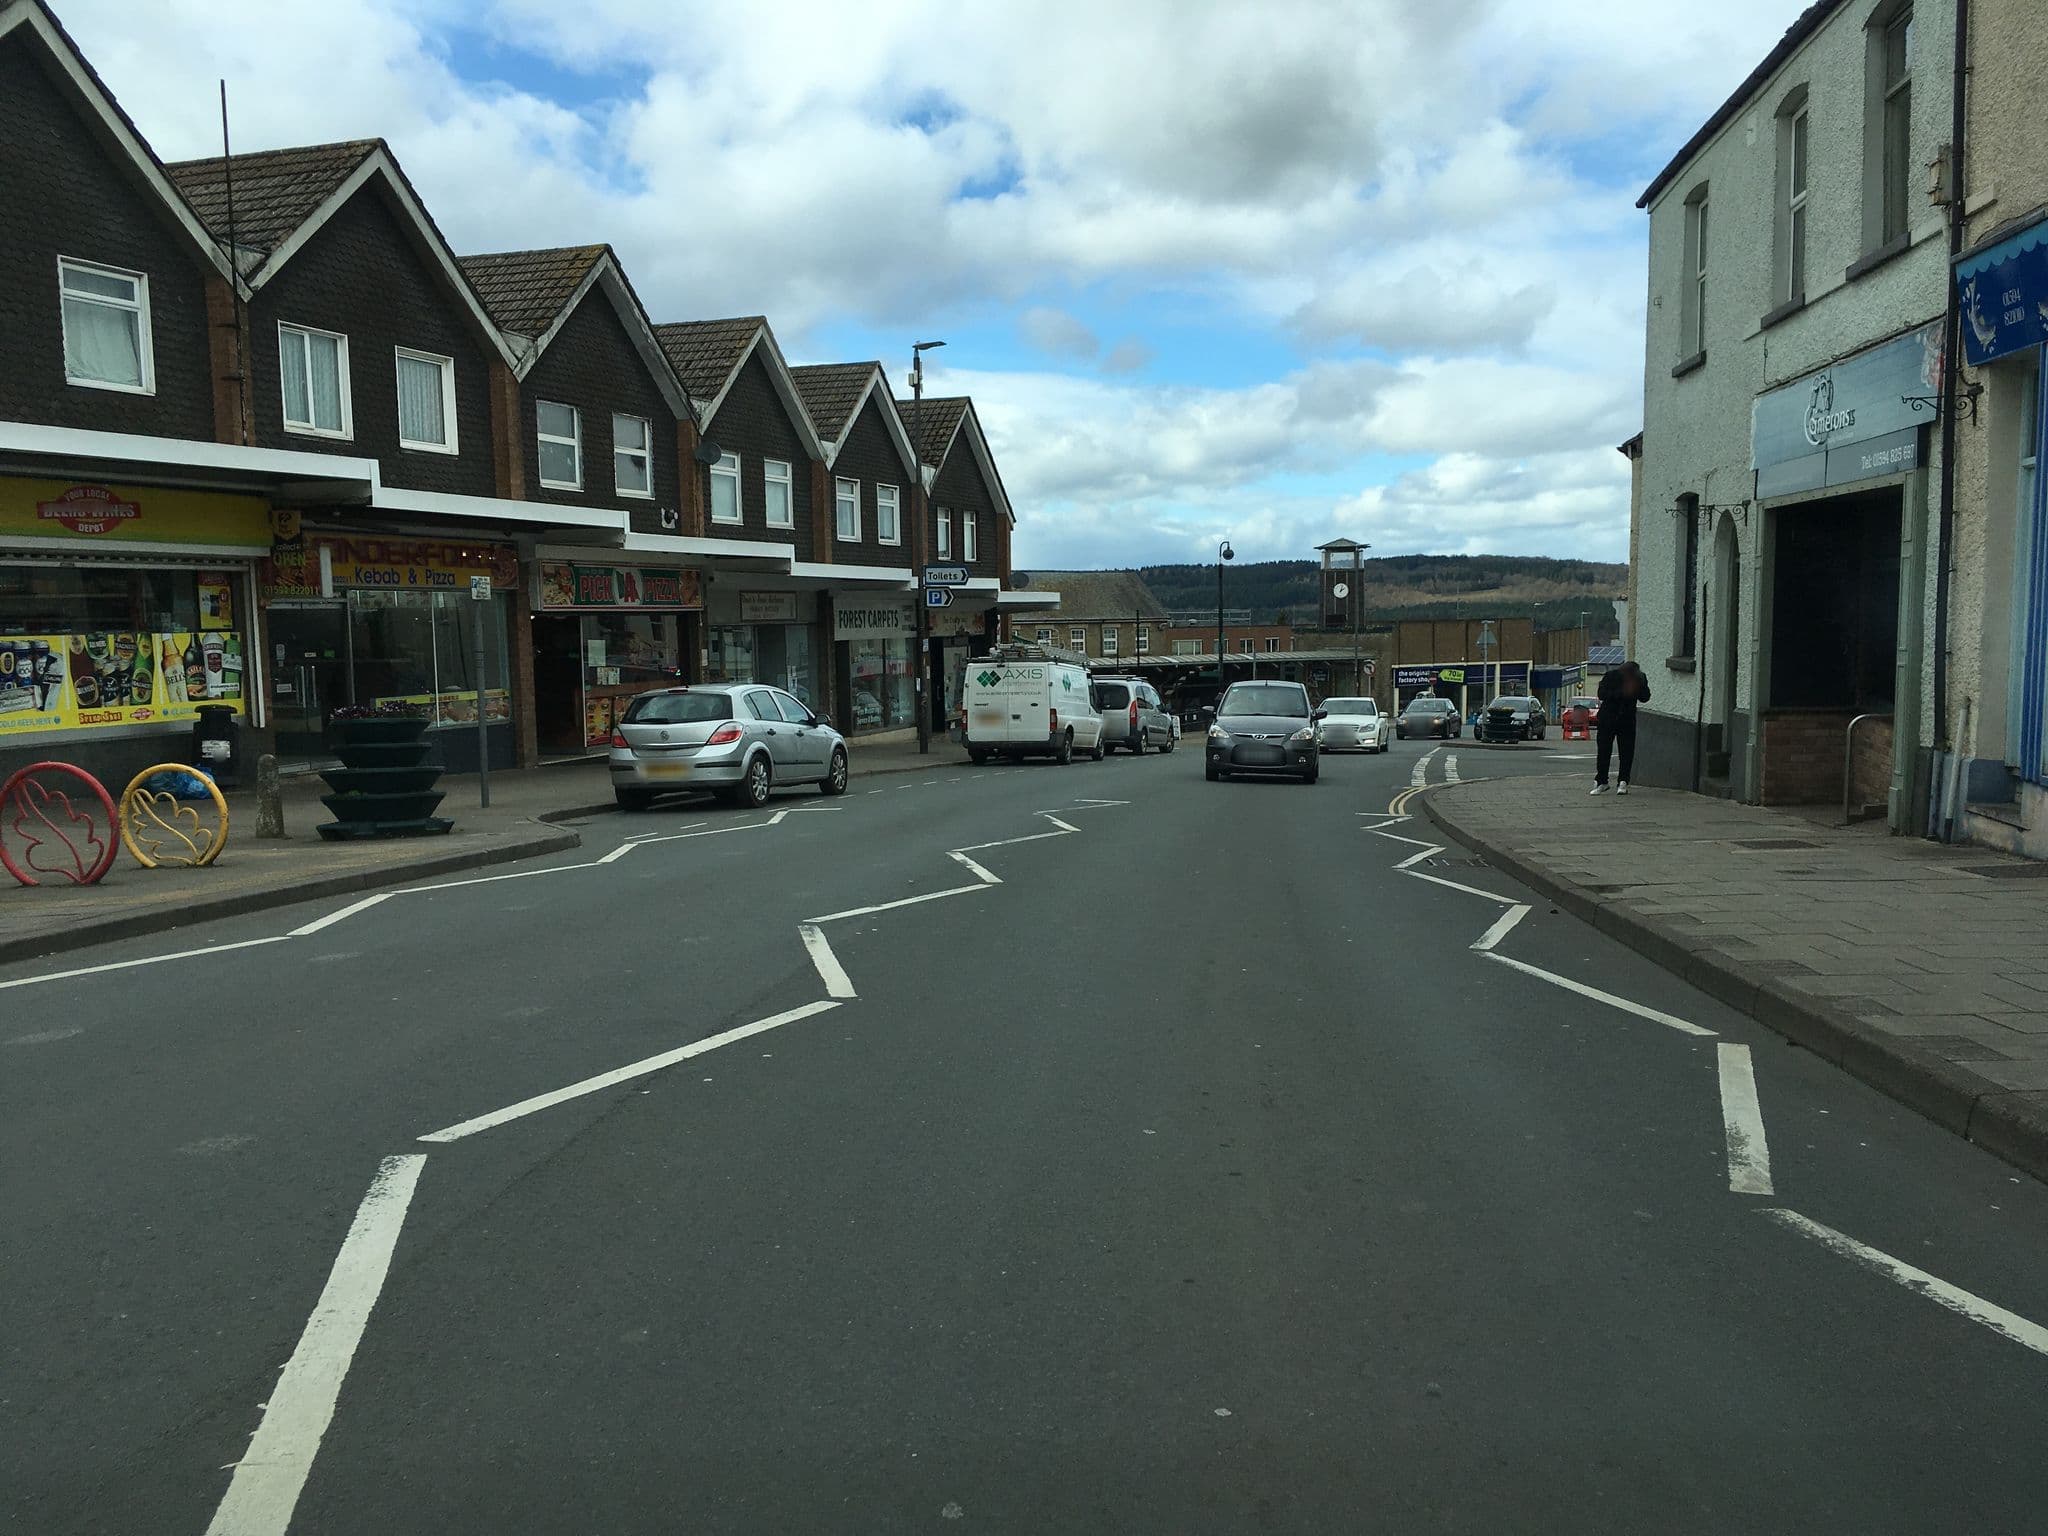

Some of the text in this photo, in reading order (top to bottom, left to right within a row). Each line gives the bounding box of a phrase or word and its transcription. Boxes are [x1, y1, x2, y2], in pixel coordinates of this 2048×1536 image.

[64, 489, 111, 502] YOUR LOCAL
[78, 523, 105, 533] DEPOT
[273, 552, 306, 567] OPEN
[354, 567, 400, 586] Kebab
[408, 568, 418, 586] &
[425, 569, 456, 586] Pizza
[928, 571, 958, 580] Toilets
[643, 577, 680, 602] PIZZA
[932, 592, 940, 603] P
[838, 609, 899, 629] FOREST CARPETS
[1002, 668, 1043, 680] AXIS
